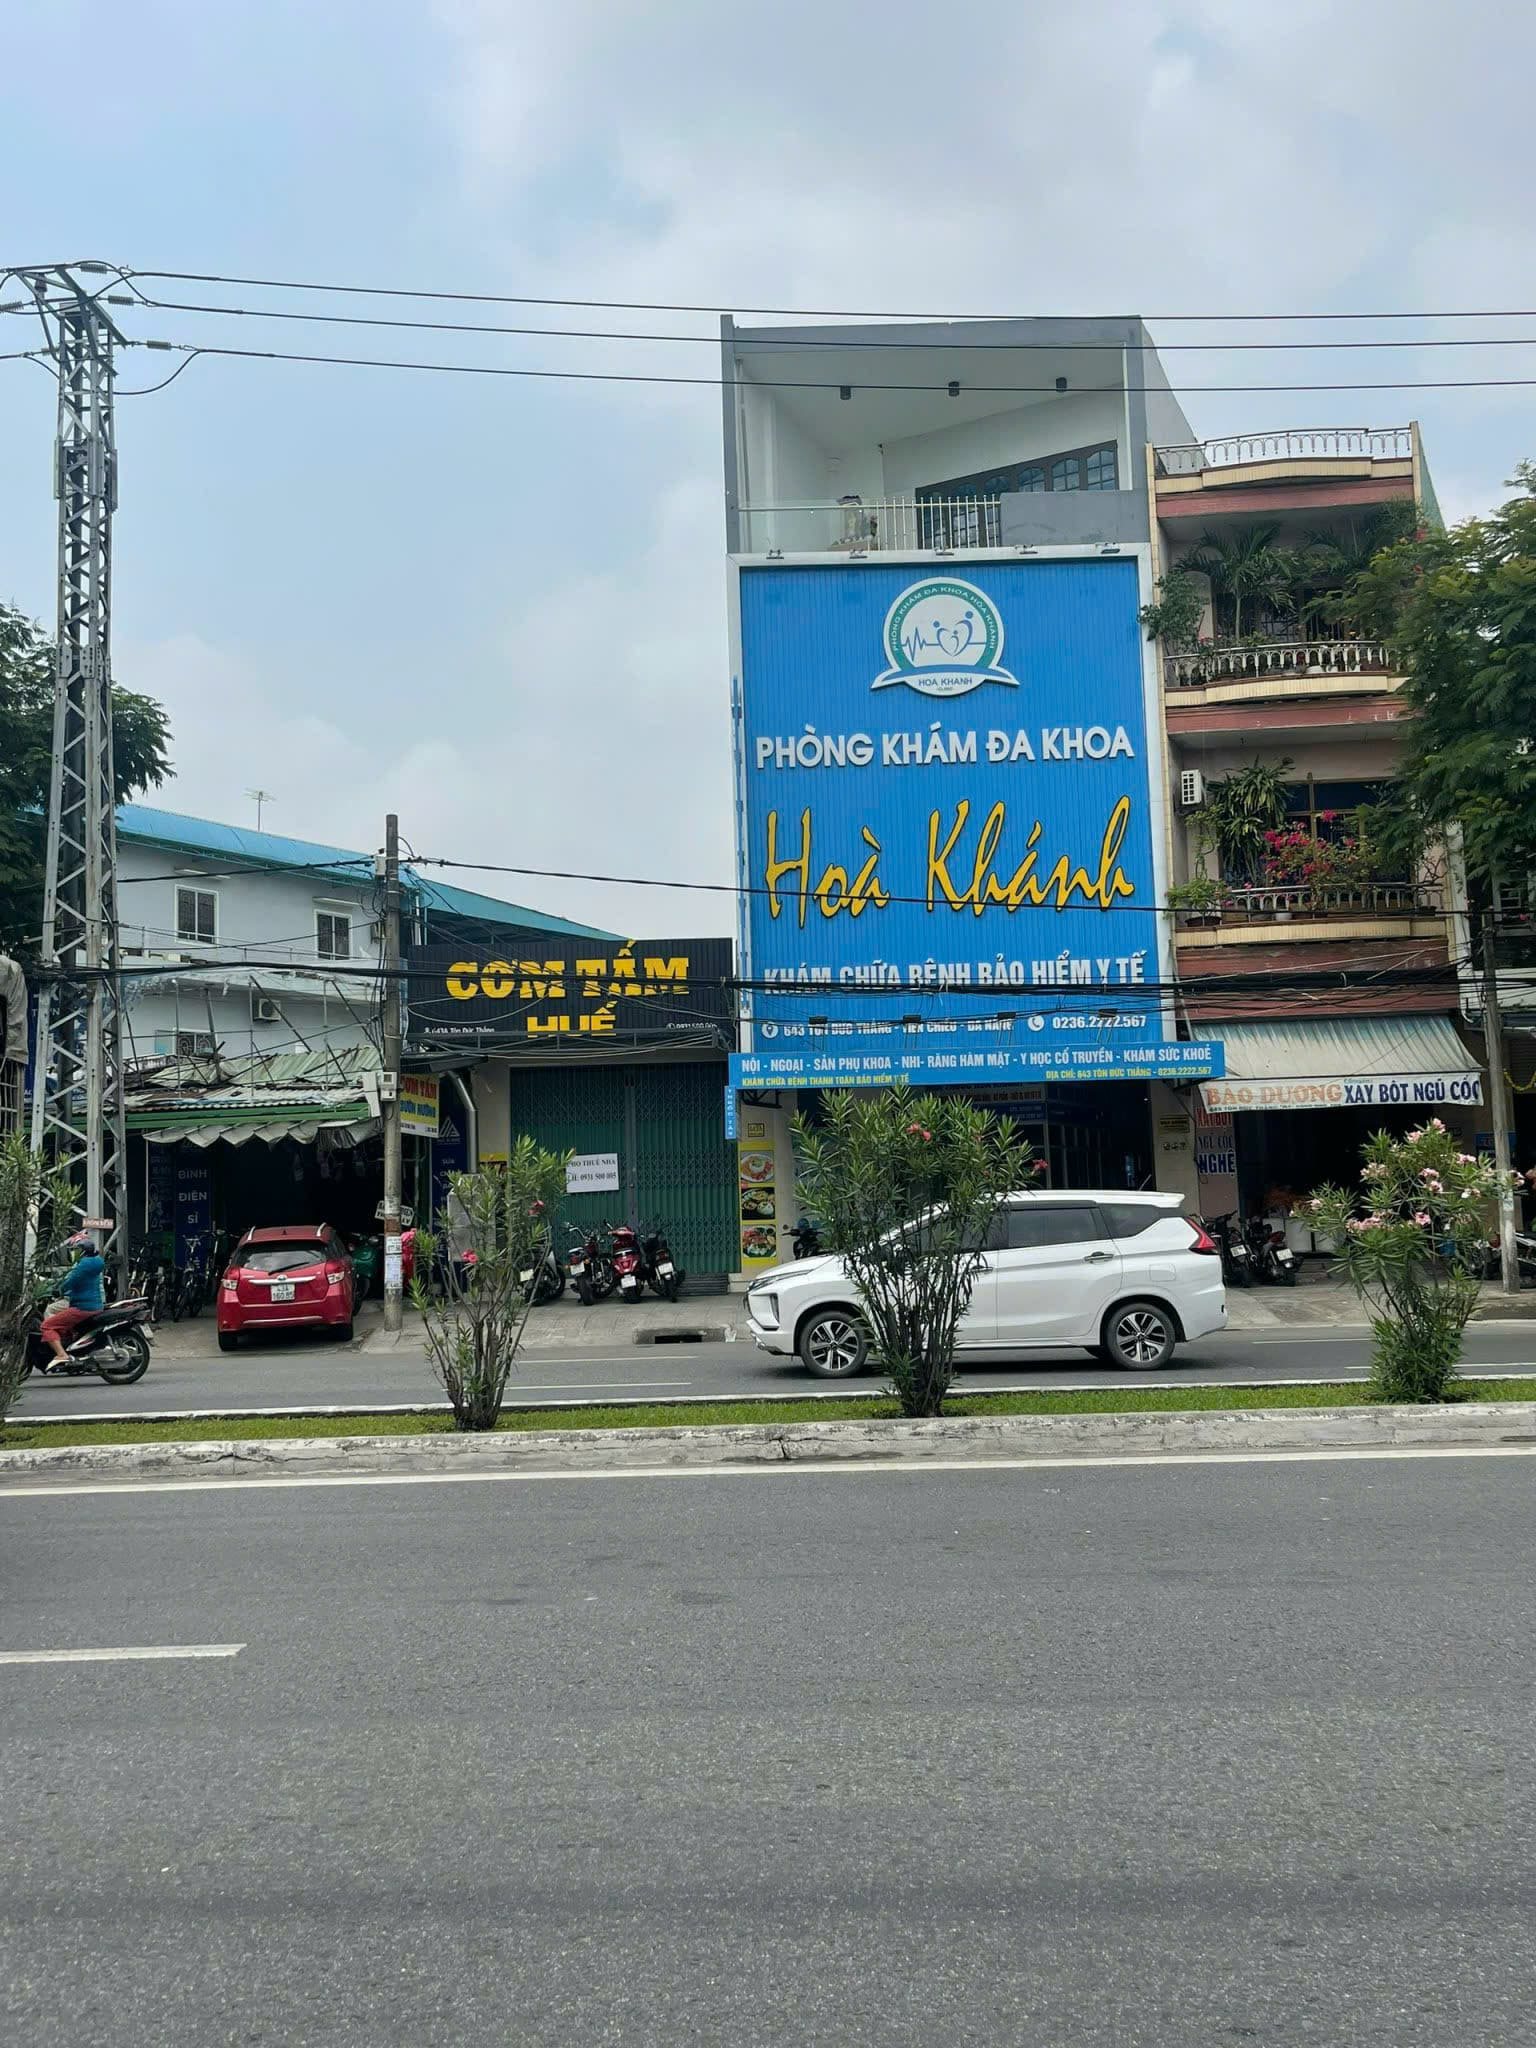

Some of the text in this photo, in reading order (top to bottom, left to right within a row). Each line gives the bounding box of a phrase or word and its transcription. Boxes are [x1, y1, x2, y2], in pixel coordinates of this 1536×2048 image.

[756, 721, 1136, 770] PHÒNG KHÁM ĐA KHOA
[765, 795, 1136, 929] Hoà Khánh
[446, 938, 689, 1000] CƠM TẤM
[764, 962, 832, 994] KHÁM
[840, 959, 902, 990] CHỮA
[977, 953, 1025, 986] BẢO
[1031, 949, 1092, 986] HIỂM
[1096, 958, 1111, 985] Y
[1116, 949, 1148, 985] TẾ
[527, 1000, 617, 1037] HUẾ
[1052, 1015, 1147, 1030] 0236.2222.567
[742, 1057, 761, 1075] NỘI
[770, 1058, 804, 1074] NGOẠI
[813, 1054, 836, 1072] SẢN
[838, 1057, 861, 1073] PHỤ
[863, 1056, 892, 1070] KHOA
[927, 1052, 957, 1069] RĂNG
[960, 1052, 985, 1067] HÀM
[987, 1052, 1010, 1068] MẶT
[1020, 1052, 1027, 1065] Y
[1030, 1051, 1052, 1067] HỌC
[1055, 1047, 1070, 1064] CỔ
[1072, 1046, 1114, 1063] TRUYỀN
[1123, 1047, 1155, 1062] KHÁM
[1158, 1046, 1180, 1062] SỨC
[1183, 1044, 1212, 1061] KHOẺ
[810, 1075, 834, 1085] THANH
[1344, 1084, 1373, 1104] XAY
[1413, 1078, 1445, 1101] NGŨ
[1198, 1149, 1236, 1176] NGHỆ
